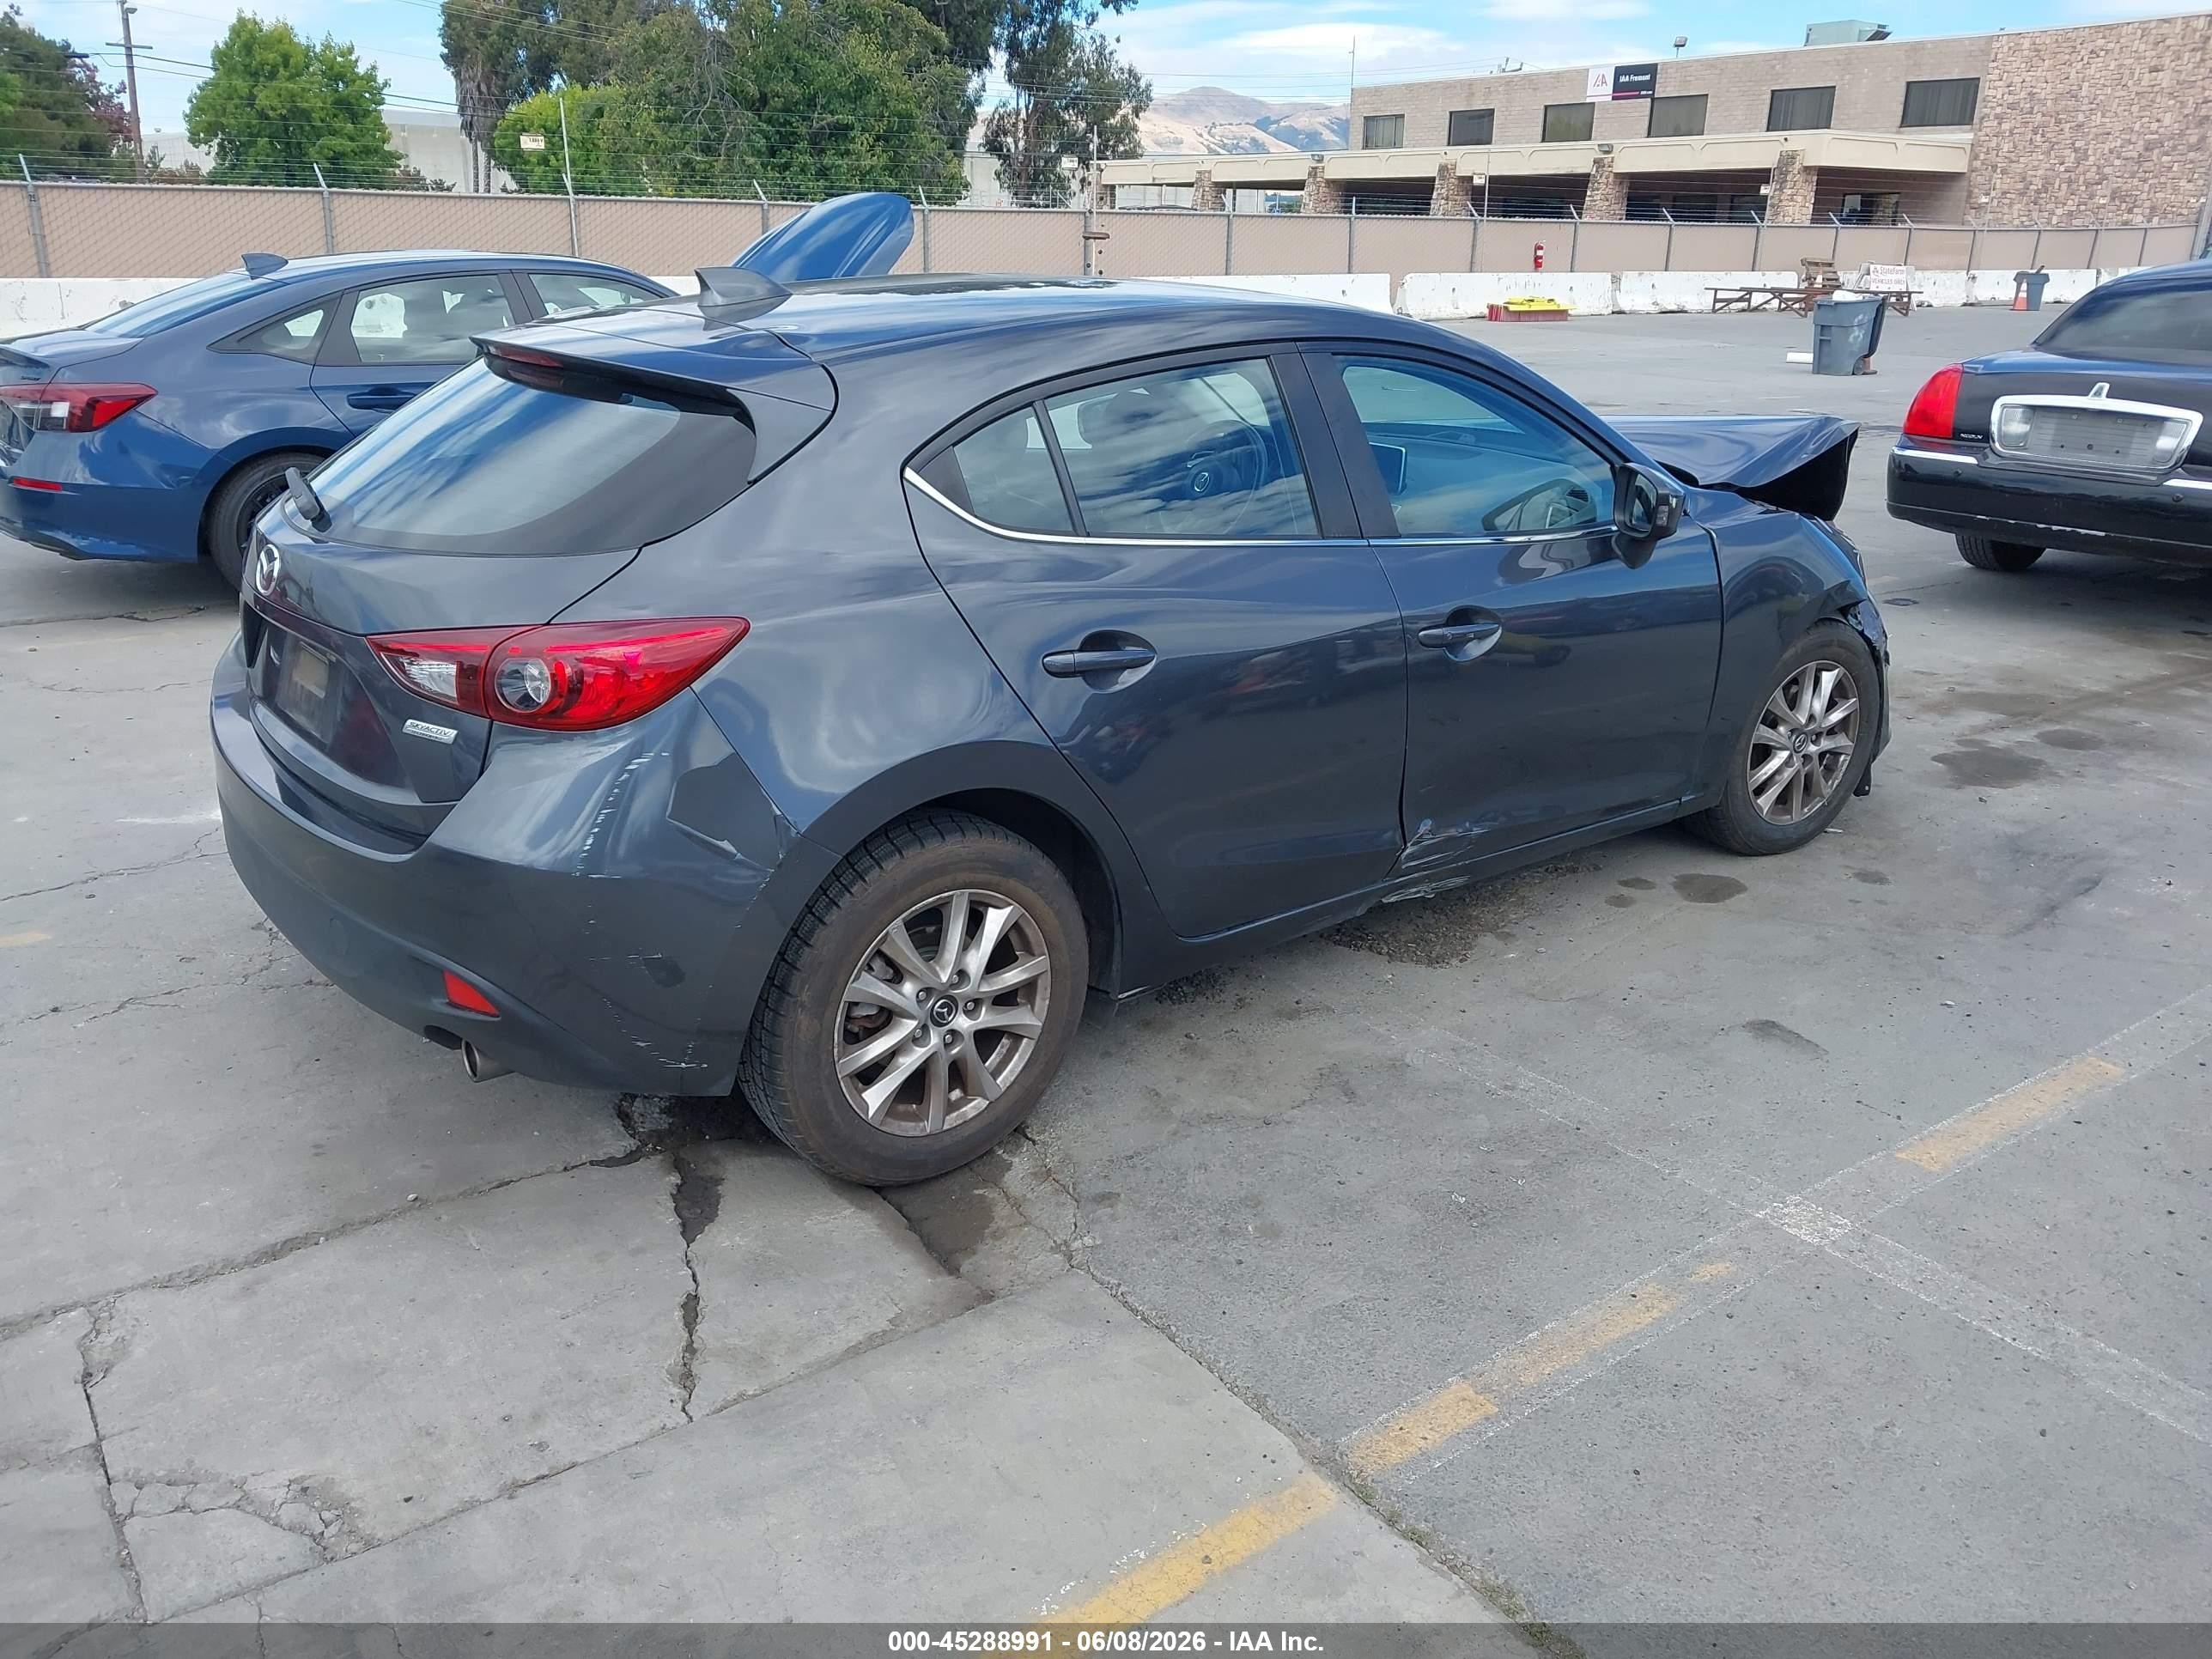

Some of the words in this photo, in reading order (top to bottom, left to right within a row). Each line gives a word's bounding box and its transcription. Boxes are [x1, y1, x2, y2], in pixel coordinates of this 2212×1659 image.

[1619, 74, 1629, 82] IAA
[1630, 73, 1650, 82] Fremont
[409, 721, 451, 737] SKYACTIV
